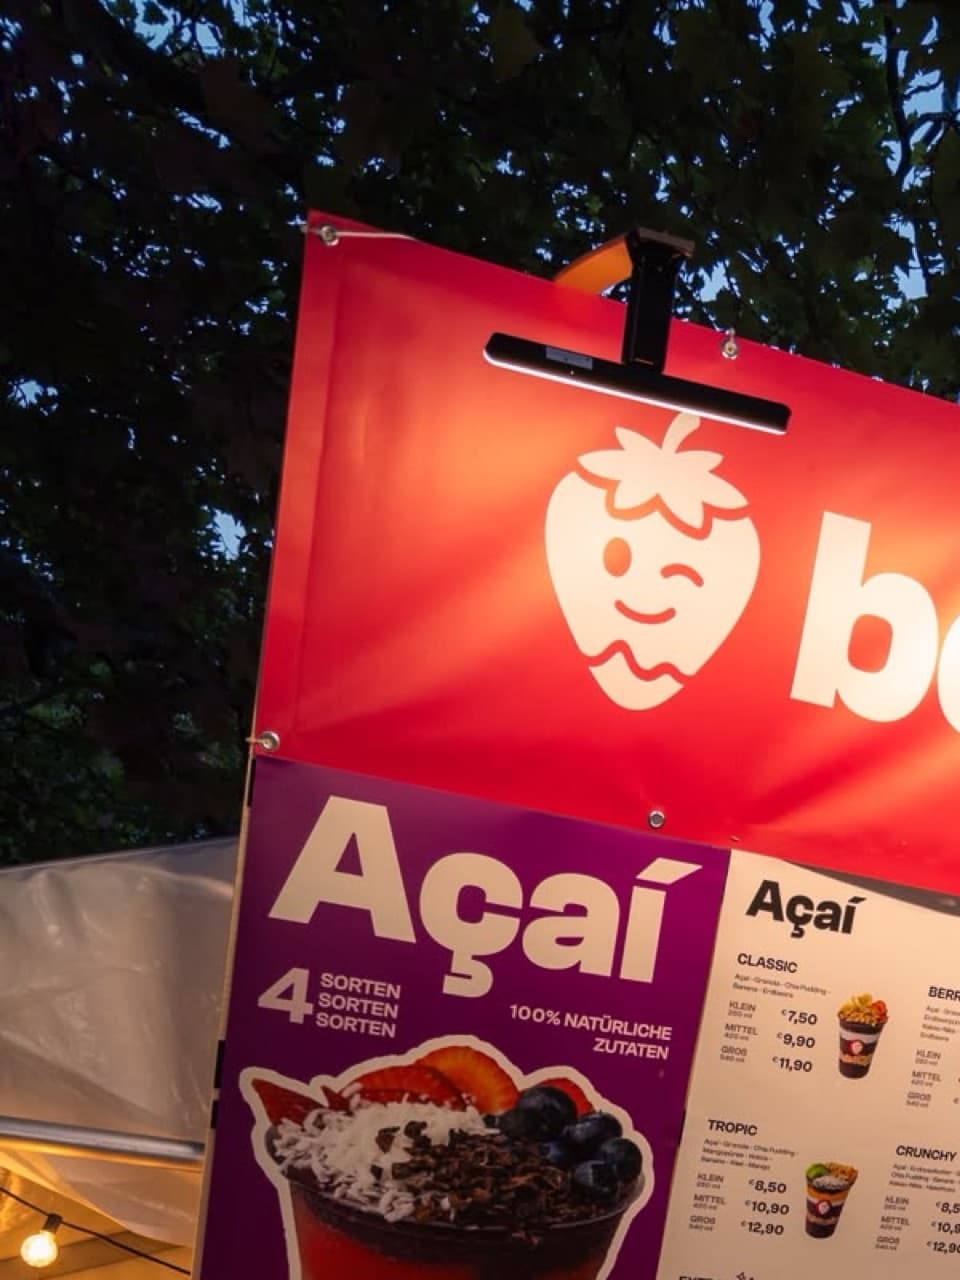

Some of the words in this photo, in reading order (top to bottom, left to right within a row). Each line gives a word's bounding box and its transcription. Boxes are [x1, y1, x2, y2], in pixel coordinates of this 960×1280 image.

[268, 795, 703, 998] Açaí
[745, 879, 867, 938] Açaí
[737, 953, 798, 974] CLASSIC
[257, 968, 314, 1024] 4
[320, 973, 401, 999] SORTEN
[318, 992, 399, 1019] SORTEN
[316, 1012, 396, 1038] SORTEN
[510, 1004, 562, 1026] 100%
[564, 1013, 673, 1042] NATÜRLICHE
[593, 1037, 671, 1060] ZUTATEN
[708, 1119, 758, 1137] TROPIC
[896, 1145, 957, 1162] CRUNCHY
